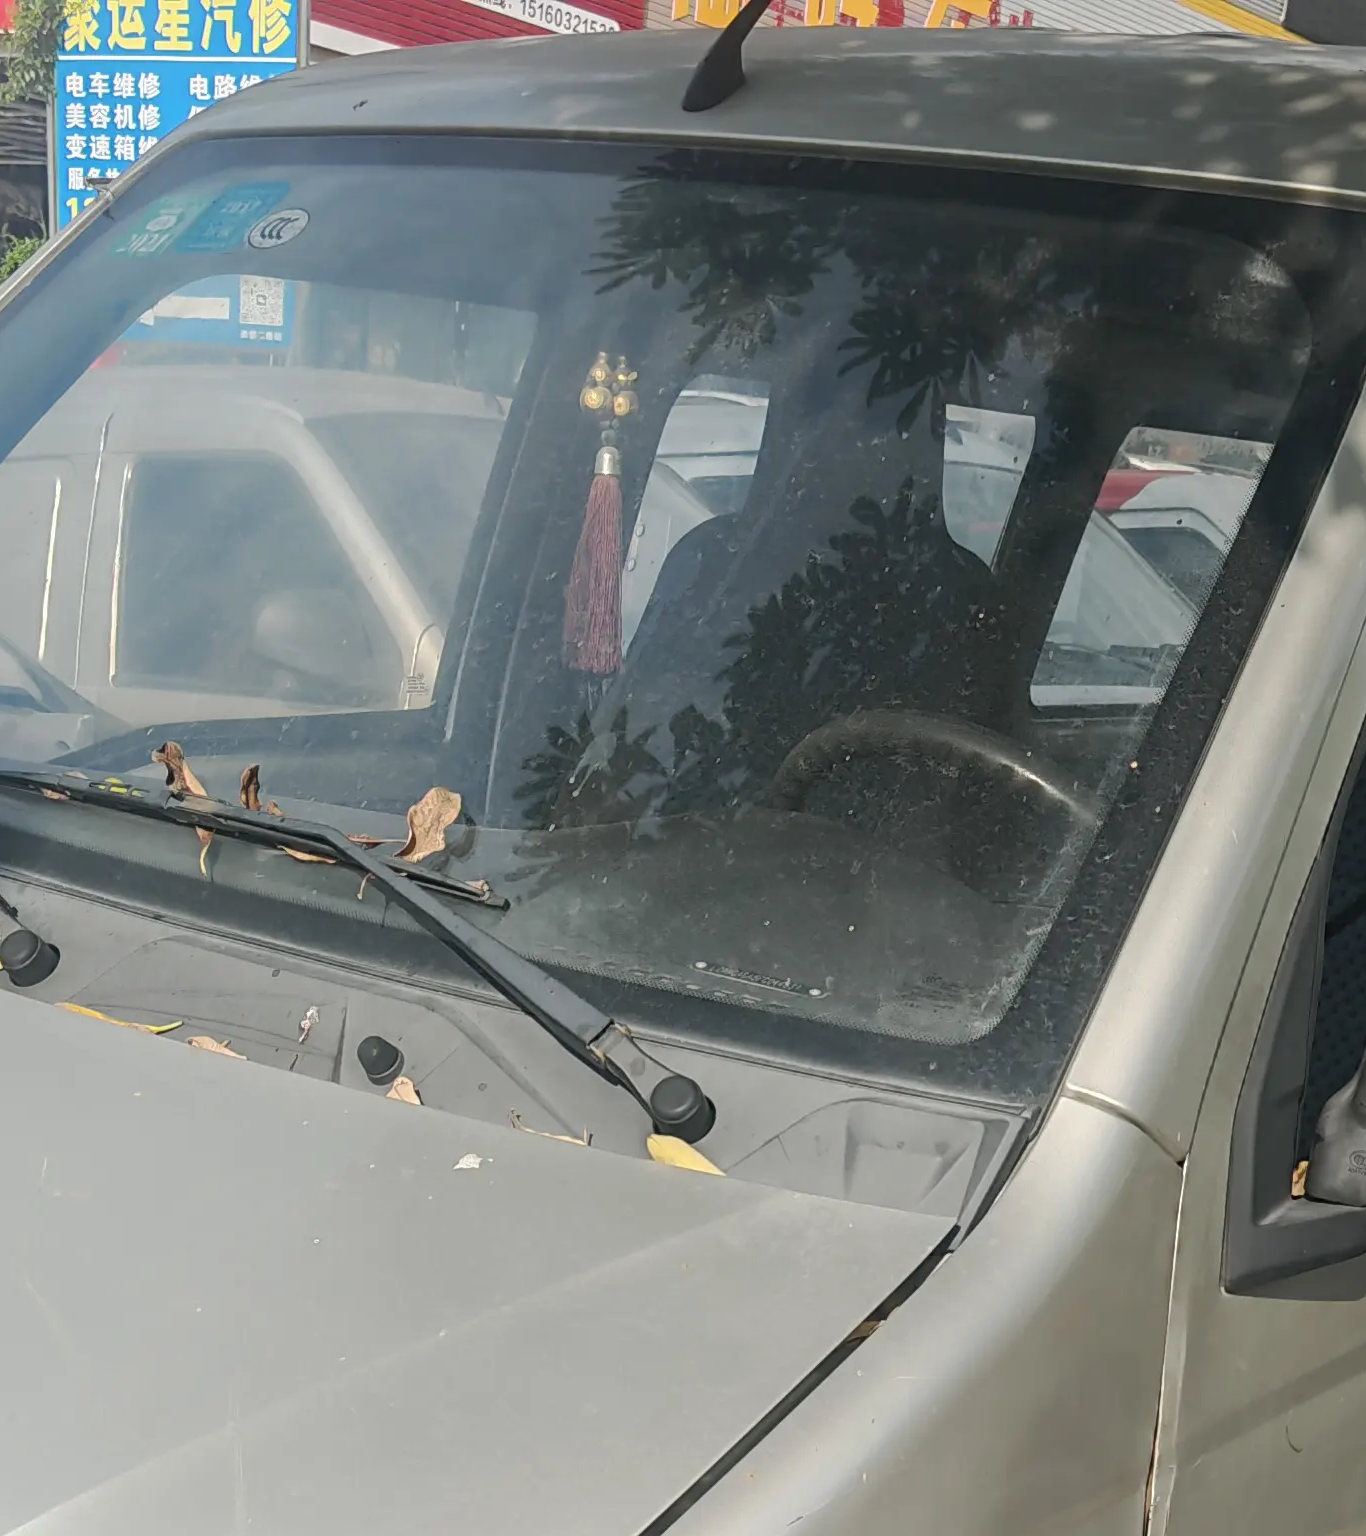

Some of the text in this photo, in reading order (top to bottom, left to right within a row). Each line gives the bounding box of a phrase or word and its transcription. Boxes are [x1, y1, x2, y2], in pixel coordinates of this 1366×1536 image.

[65, 72, 276, 101] 电车维修 电路
[65, 102, 162, 131] 美容机修
